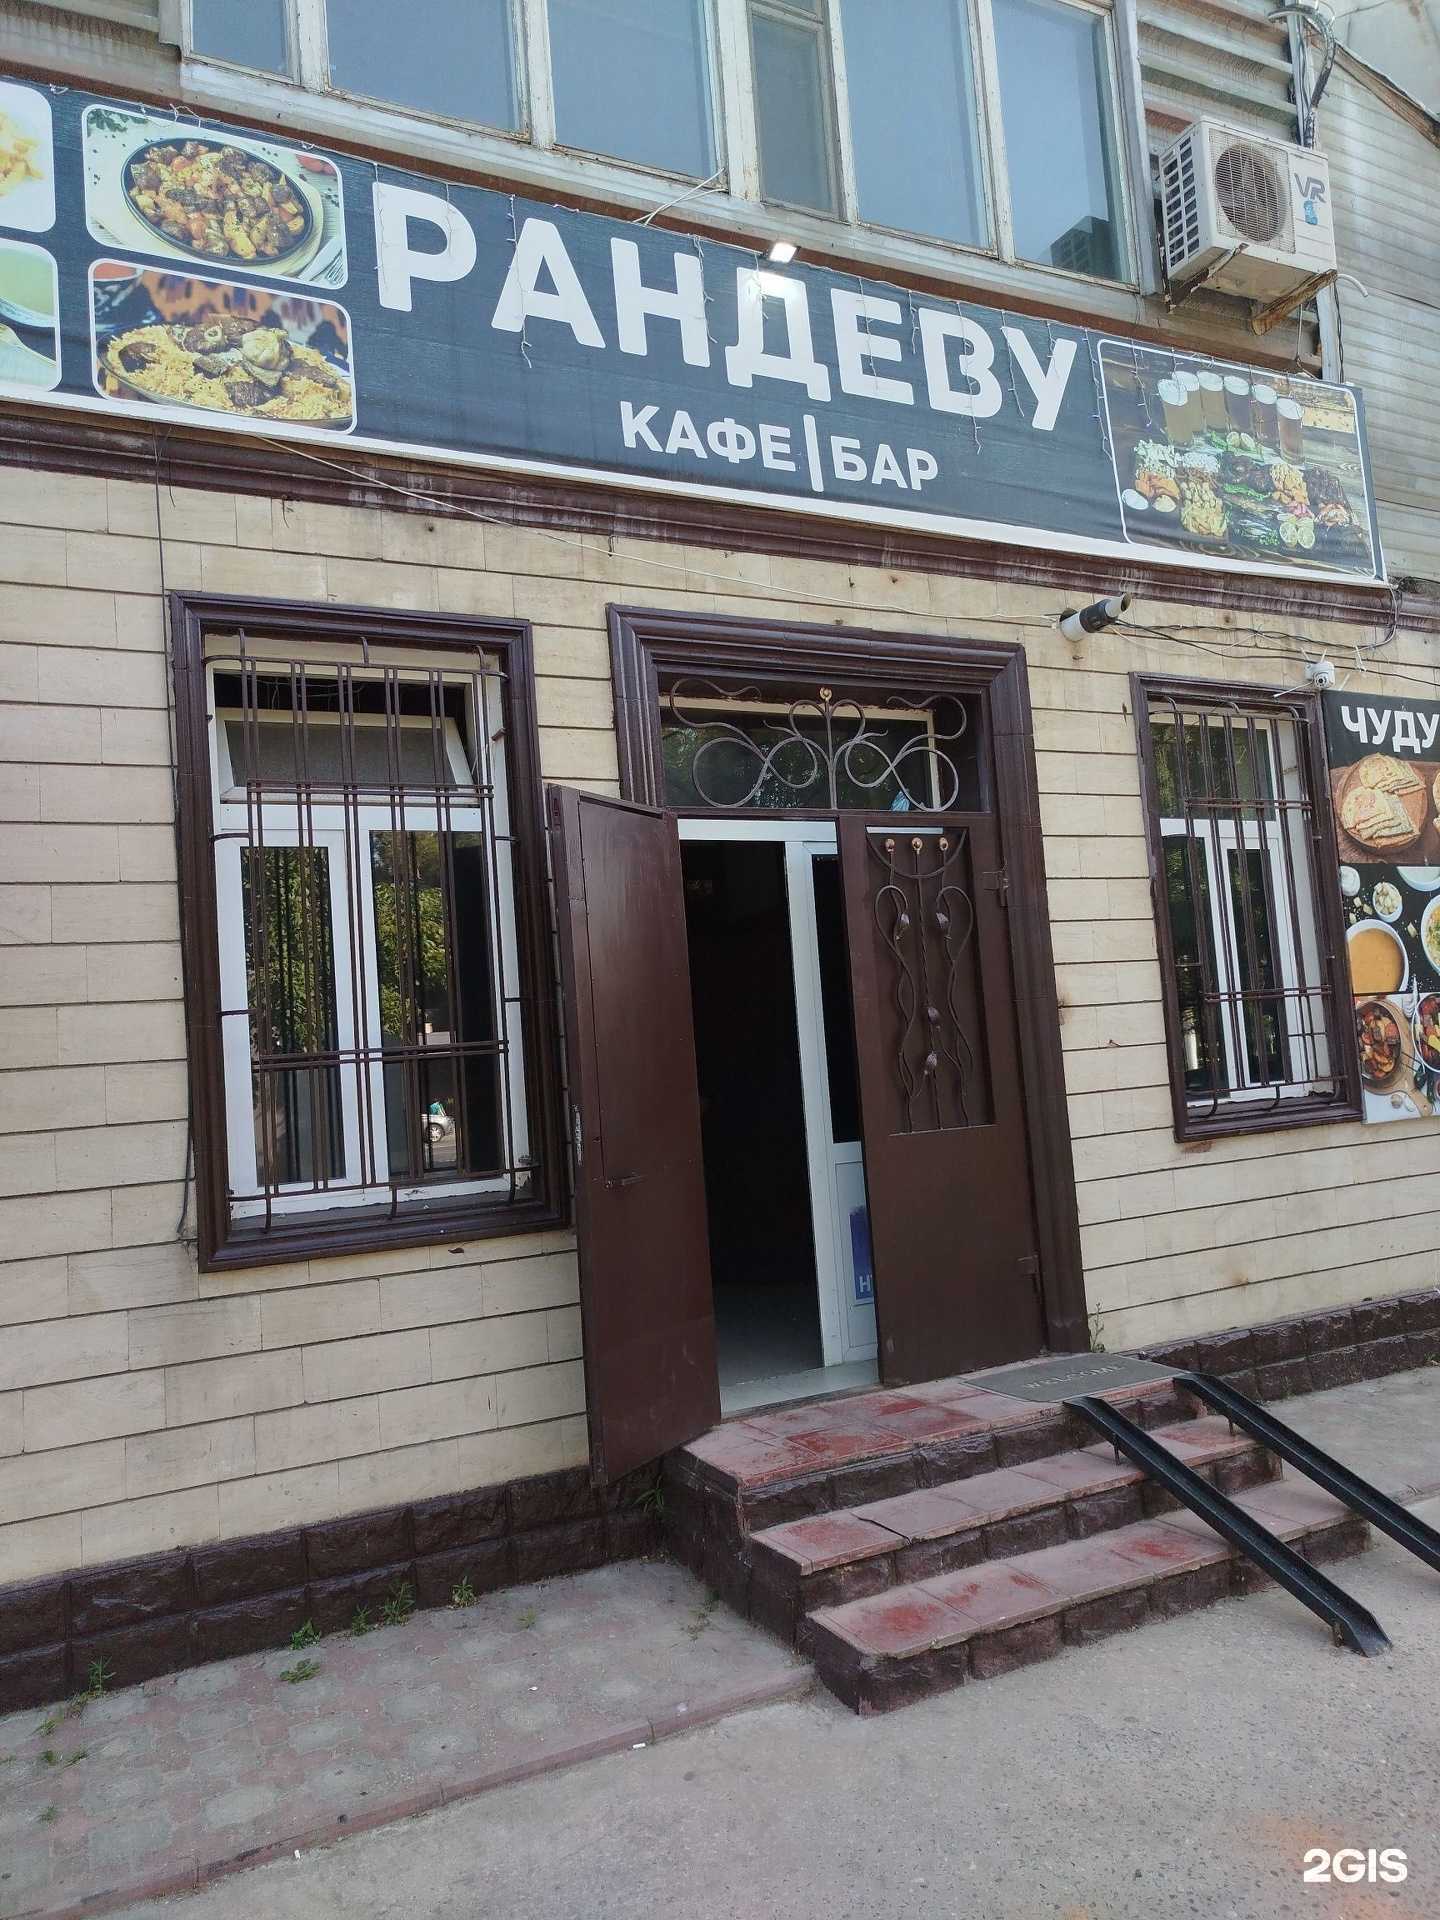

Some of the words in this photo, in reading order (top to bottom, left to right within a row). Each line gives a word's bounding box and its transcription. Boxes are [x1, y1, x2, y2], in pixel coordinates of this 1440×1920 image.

[1294, 172, 1327, 203] VR
[372, 182, 1077, 431] РАНДЕВУ
[620, 400, 796, 473] КАФЕ
[831, 435, 939, 491] БАР
[1341, 705, 1440, 754] ЧУДУ
